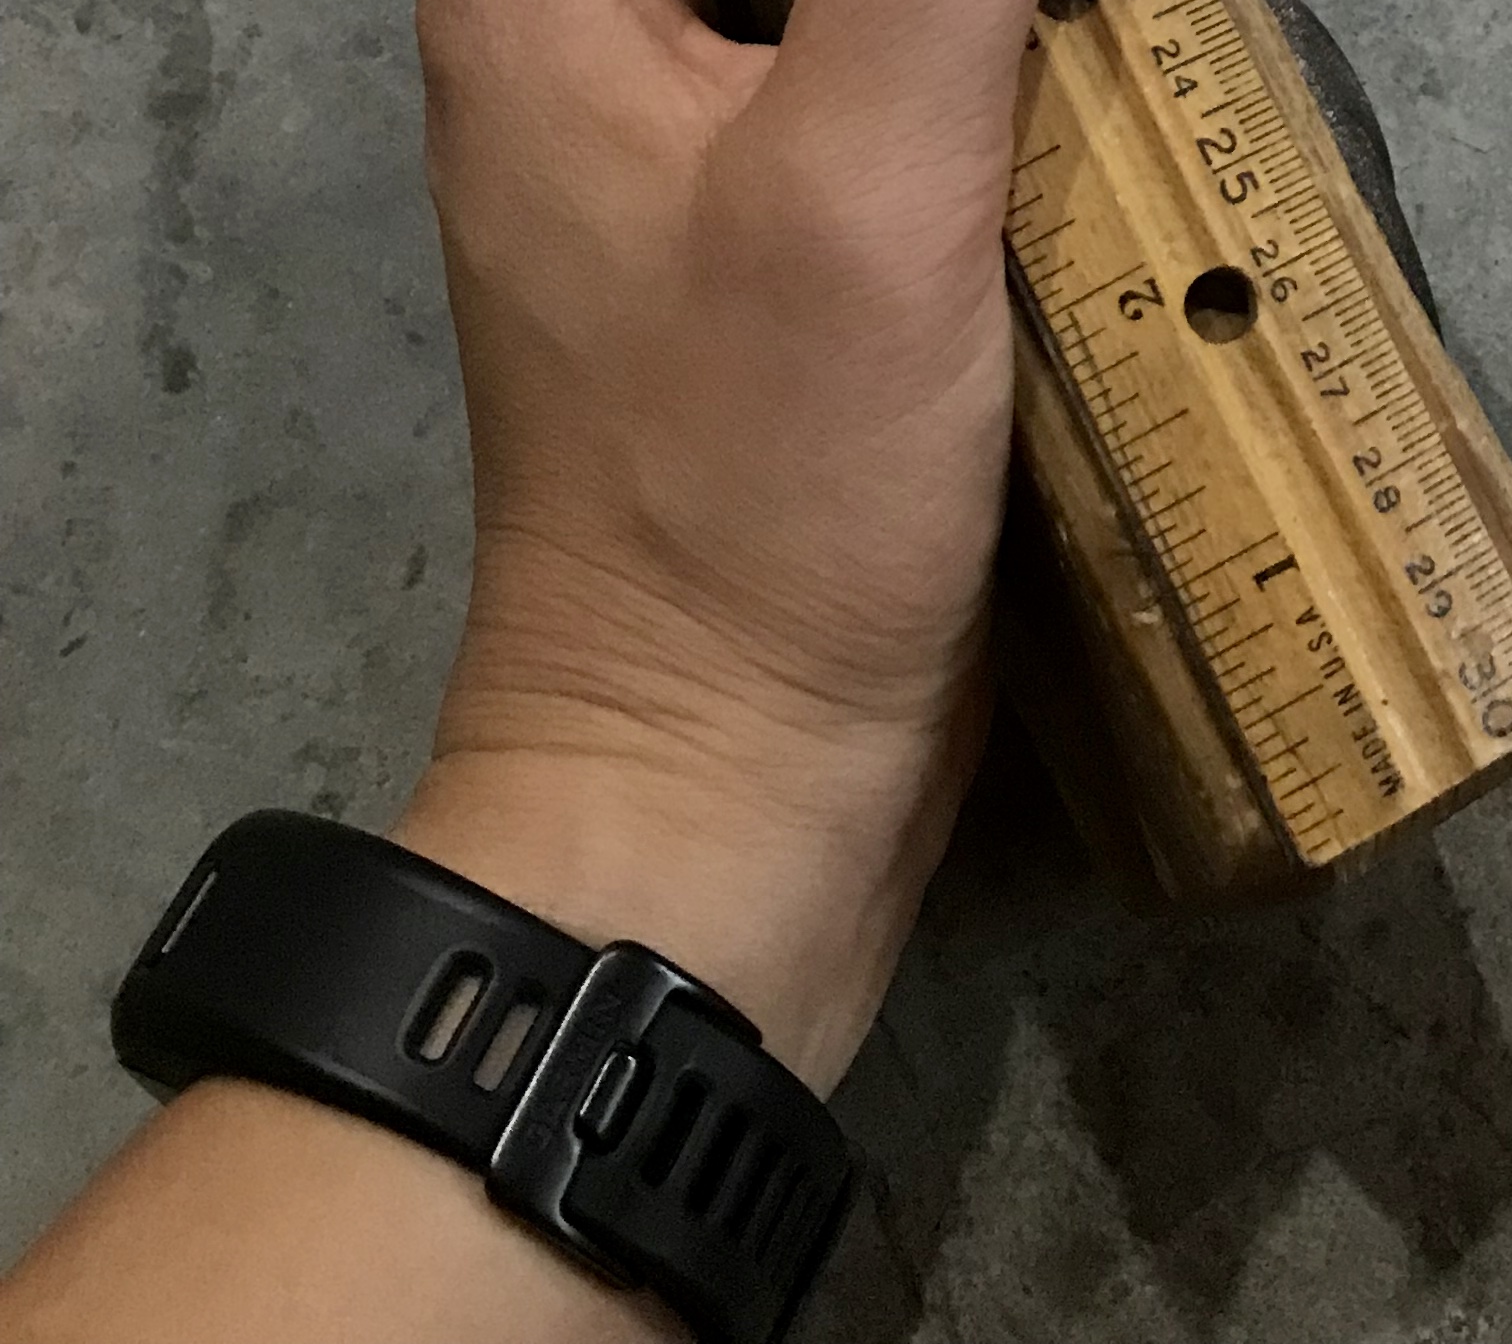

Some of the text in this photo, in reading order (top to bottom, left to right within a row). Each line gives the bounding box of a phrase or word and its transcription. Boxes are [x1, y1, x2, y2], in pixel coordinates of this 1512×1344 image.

[1151, 38, 1199, 99] 24
[1196, 127, 1260, 206] 25
[1249, 238, 1299, 305] 26
[1300, 342, 1350, 400] 27
[1352, 446, 1400, 514] 28
[1404, 554, 1453, 619] 29
[1117, 277, 1166, 322] 2
[1252, 554, 1299, 593] 1
[1333, 683, 1364, 717] IN
[1352, 719, 1405, 799] MADE
